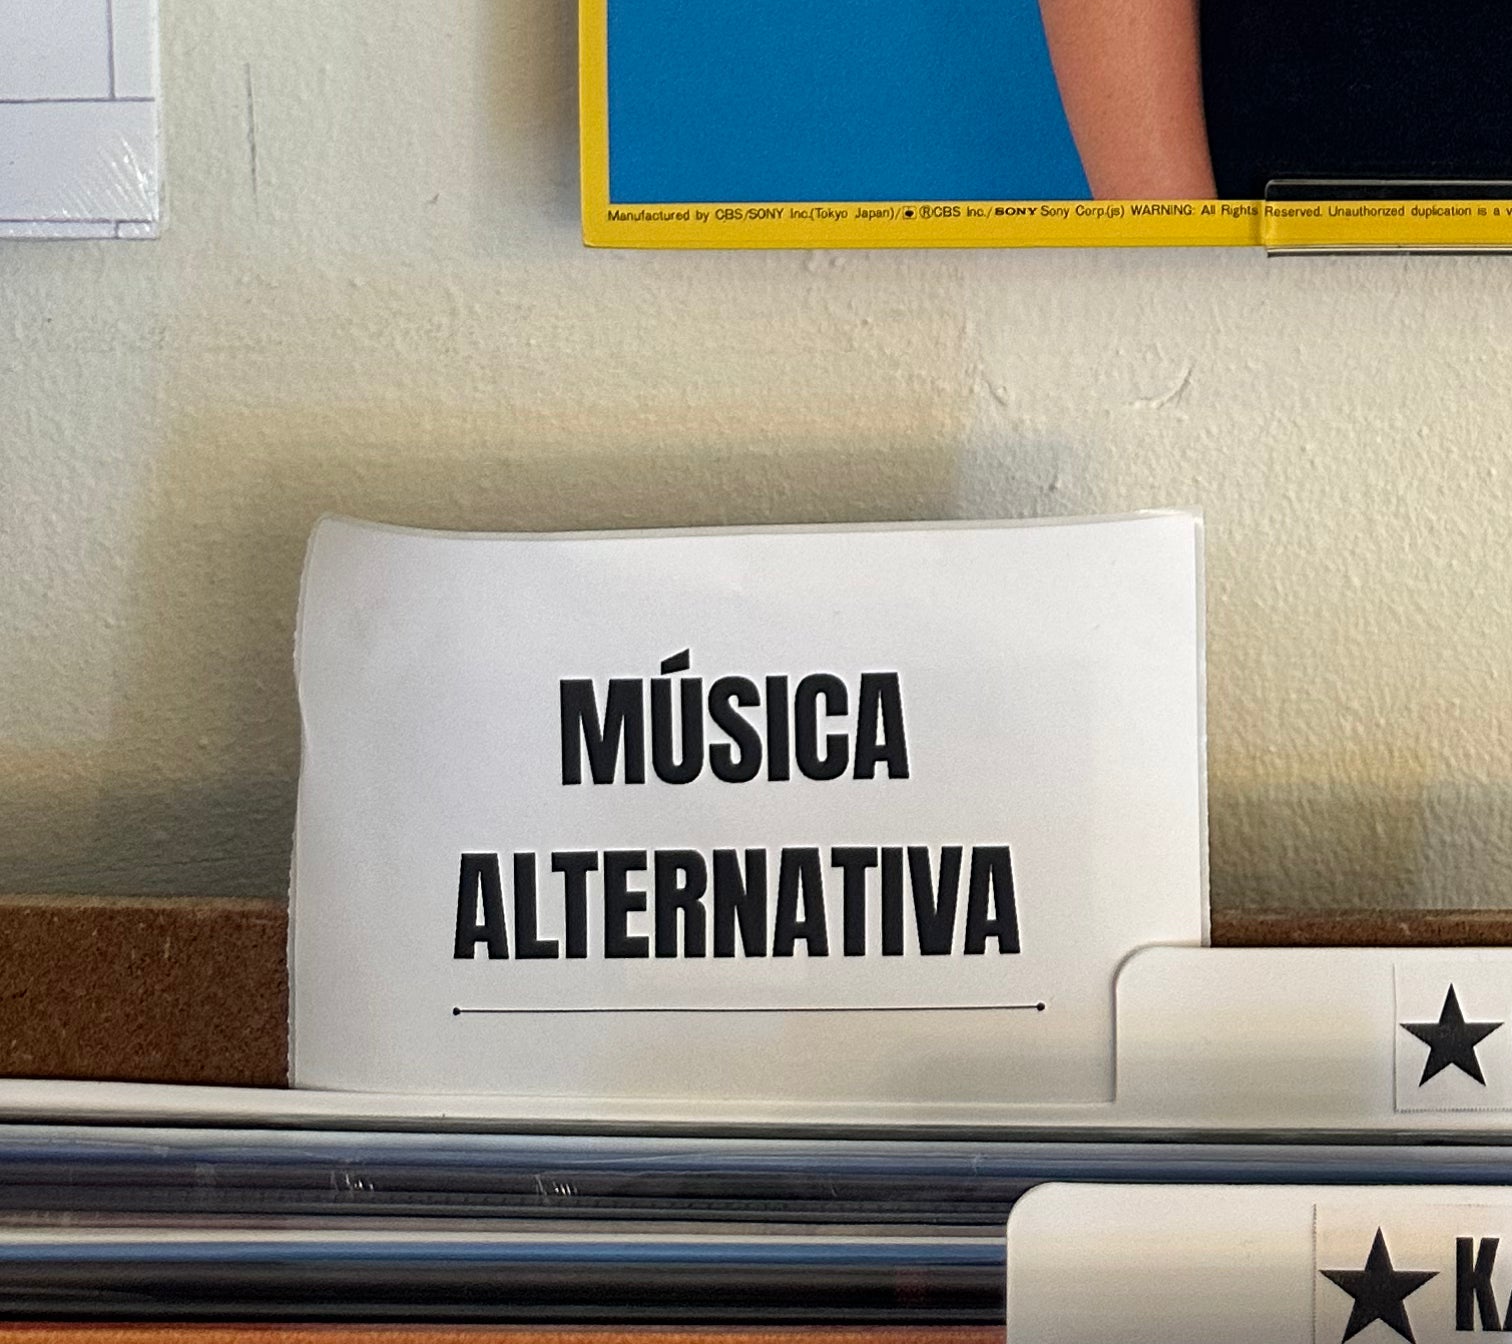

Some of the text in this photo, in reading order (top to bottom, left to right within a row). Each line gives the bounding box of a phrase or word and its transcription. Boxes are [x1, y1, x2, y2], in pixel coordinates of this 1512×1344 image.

[607, 209, 690, 222] Manufactured
[695, 209, 710, 224] by
[714, 207, 784, 223] CBS/SONY
[1040, 204, 1070, 220] Sony
[1200, 204, 1216, 216] All
[1221, 204, 1260, 219] Rights
[1328, 205, 1405, 218] Unauthorized
[1410, 204, 1472, 220] duplication
[1477, 205, 1488, 217] is
[1493, 207, 1501, 217] a
[560, 648, 910, 786] MÚSICA
[453, 845, 1022, 960] ALTERNATIVA
